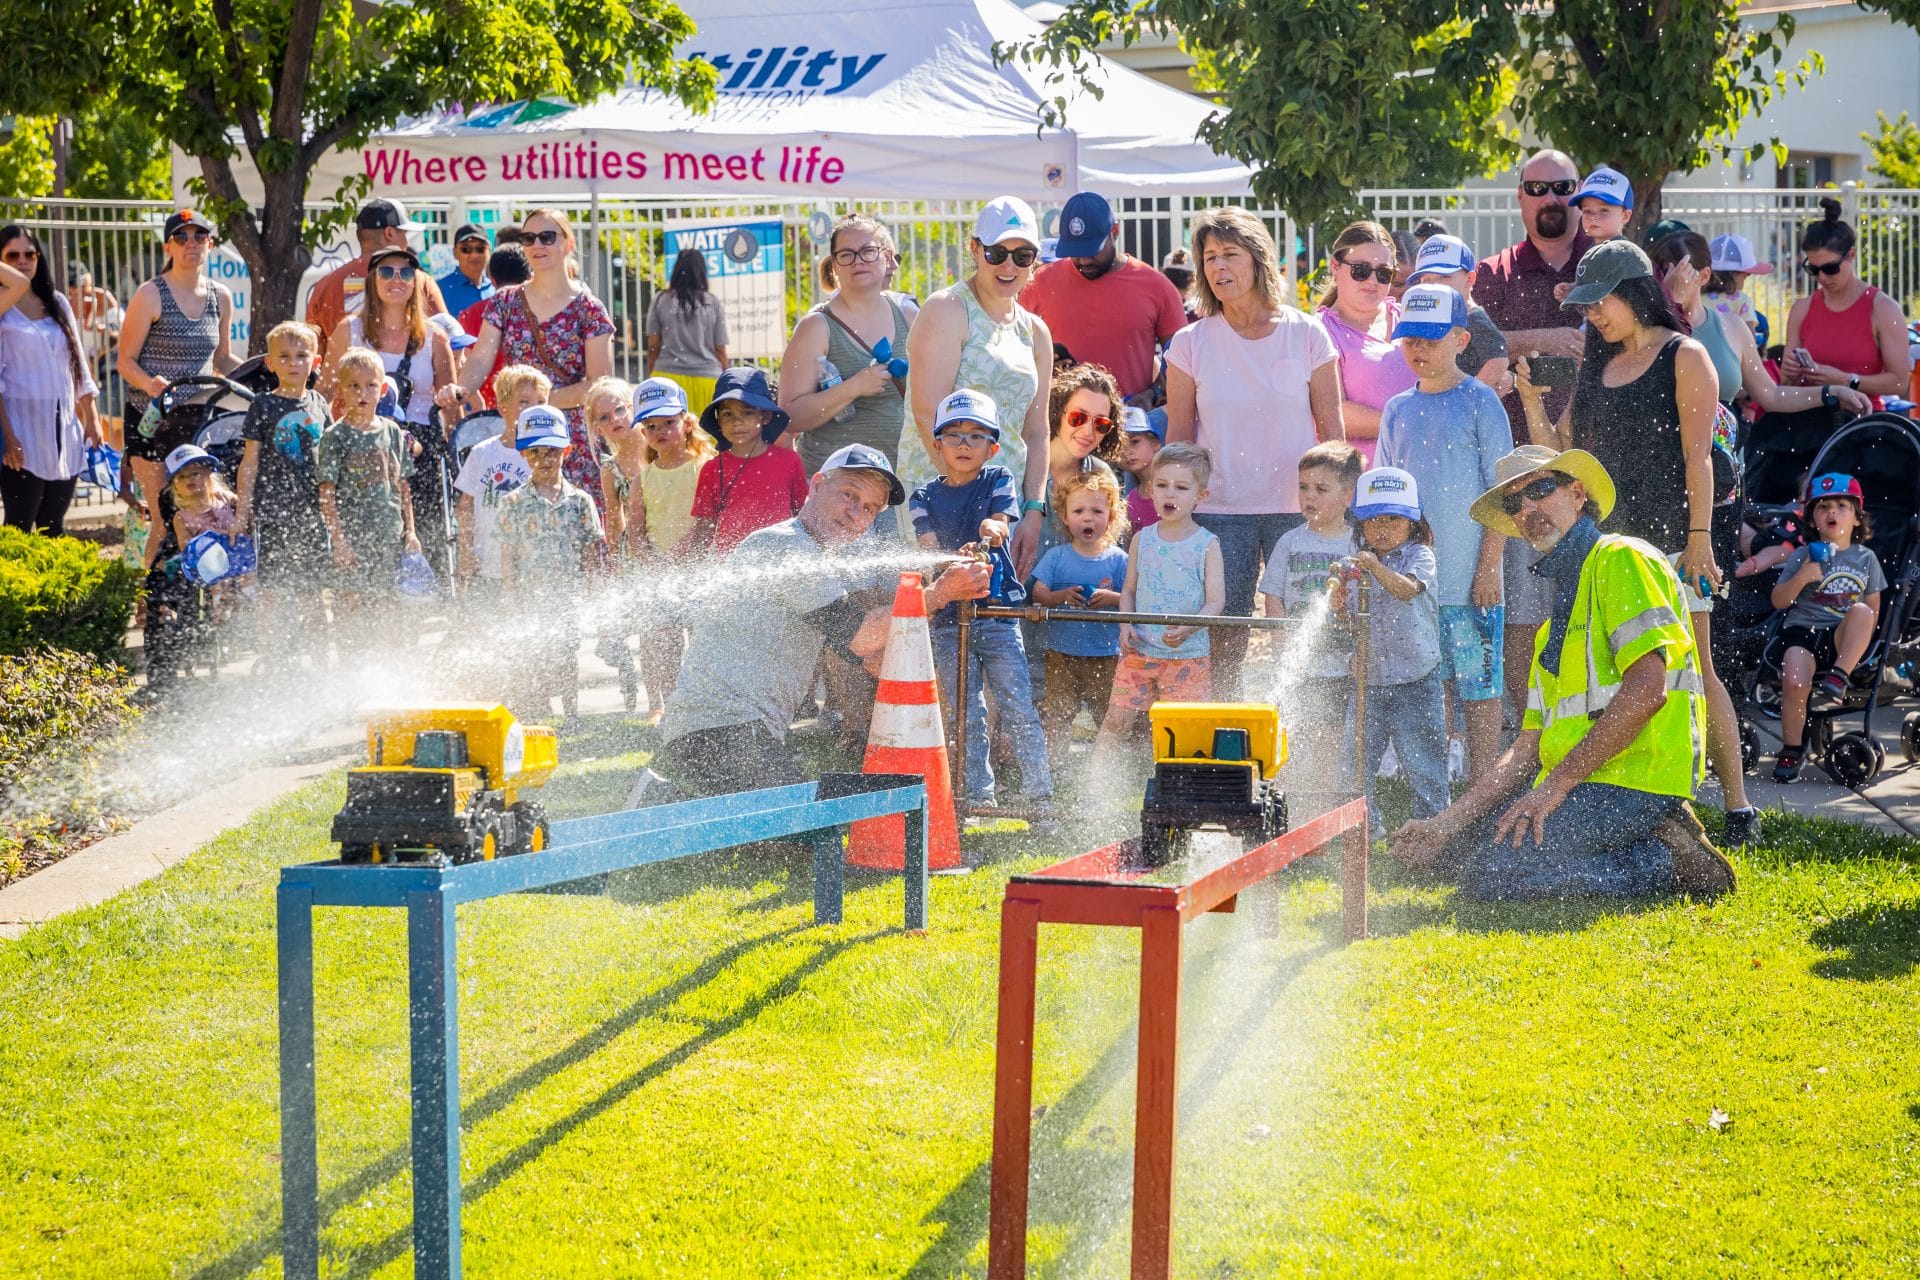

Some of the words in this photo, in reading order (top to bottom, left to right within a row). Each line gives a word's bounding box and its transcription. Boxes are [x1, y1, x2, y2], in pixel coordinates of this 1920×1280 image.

[640, 46, 887, 96] tility
[364, 149, 487, 185] Where
[502, 141, 647, 180] utilities
[664, 147, 765, 181] meet
[779, 146, 845, 184] life
[675, 228, 739, 250] WATE
[480, 462, 513, 486] EXPLORE
